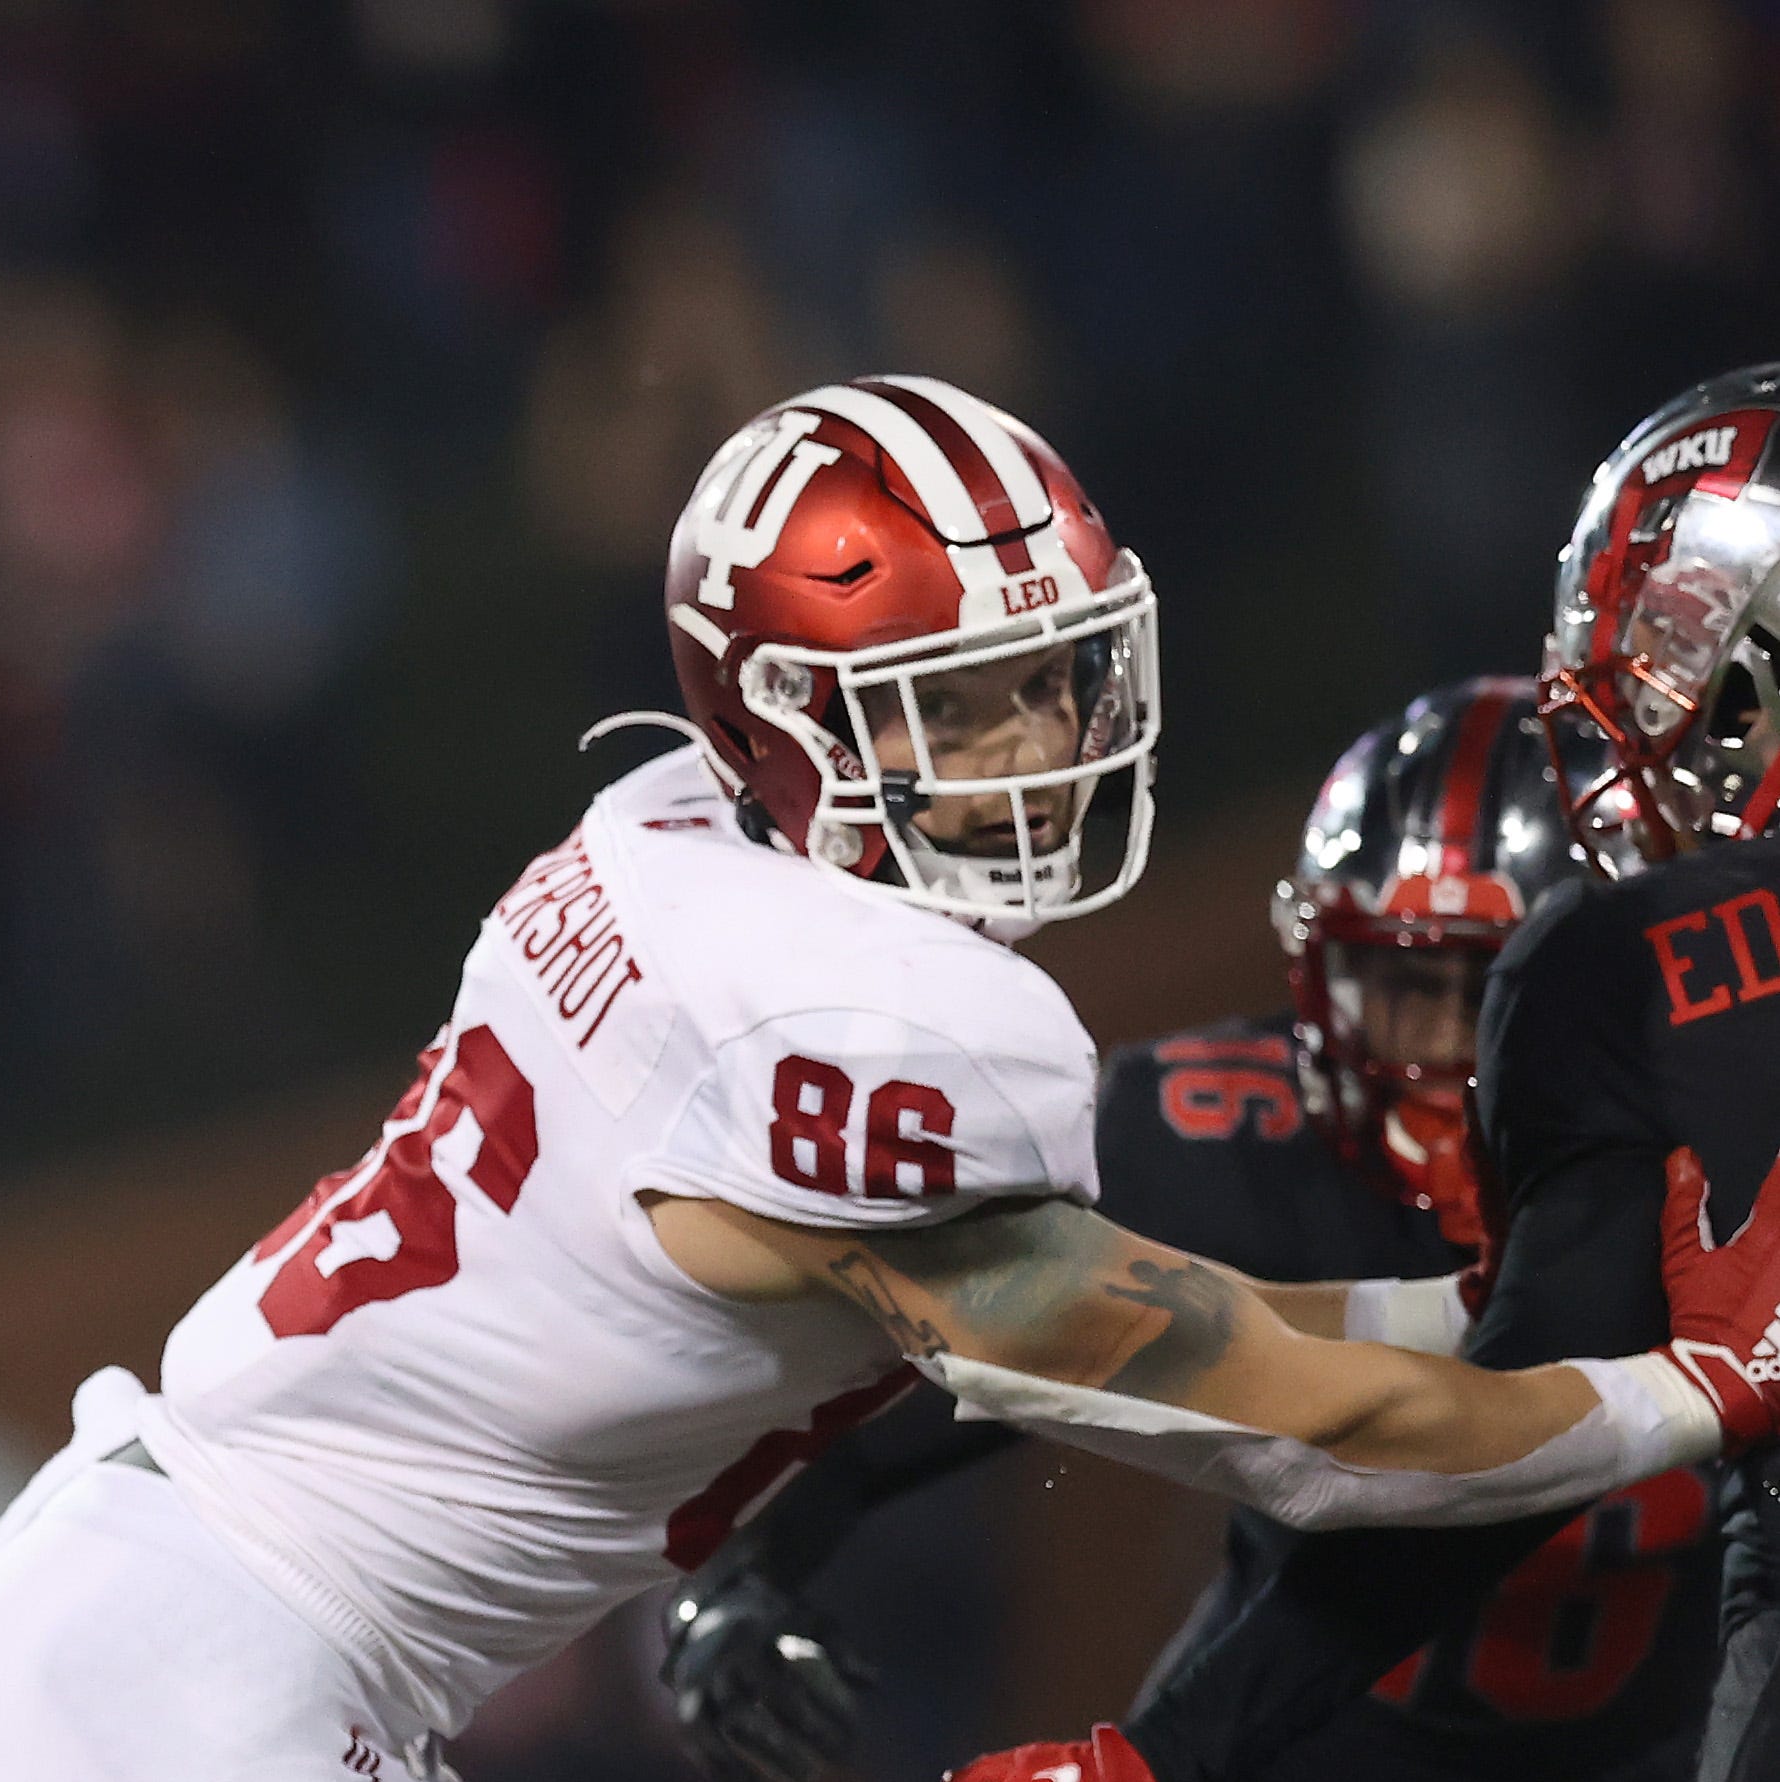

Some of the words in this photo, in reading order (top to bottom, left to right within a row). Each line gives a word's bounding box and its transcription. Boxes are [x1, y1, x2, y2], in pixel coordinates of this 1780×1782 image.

[1641, 426, 1738, 485] WKU
[1001, 574, 1060, 616] LEO
[495, 840, 644, 1051] ERSHOT
[769, 1053, 955, 1198] 86
